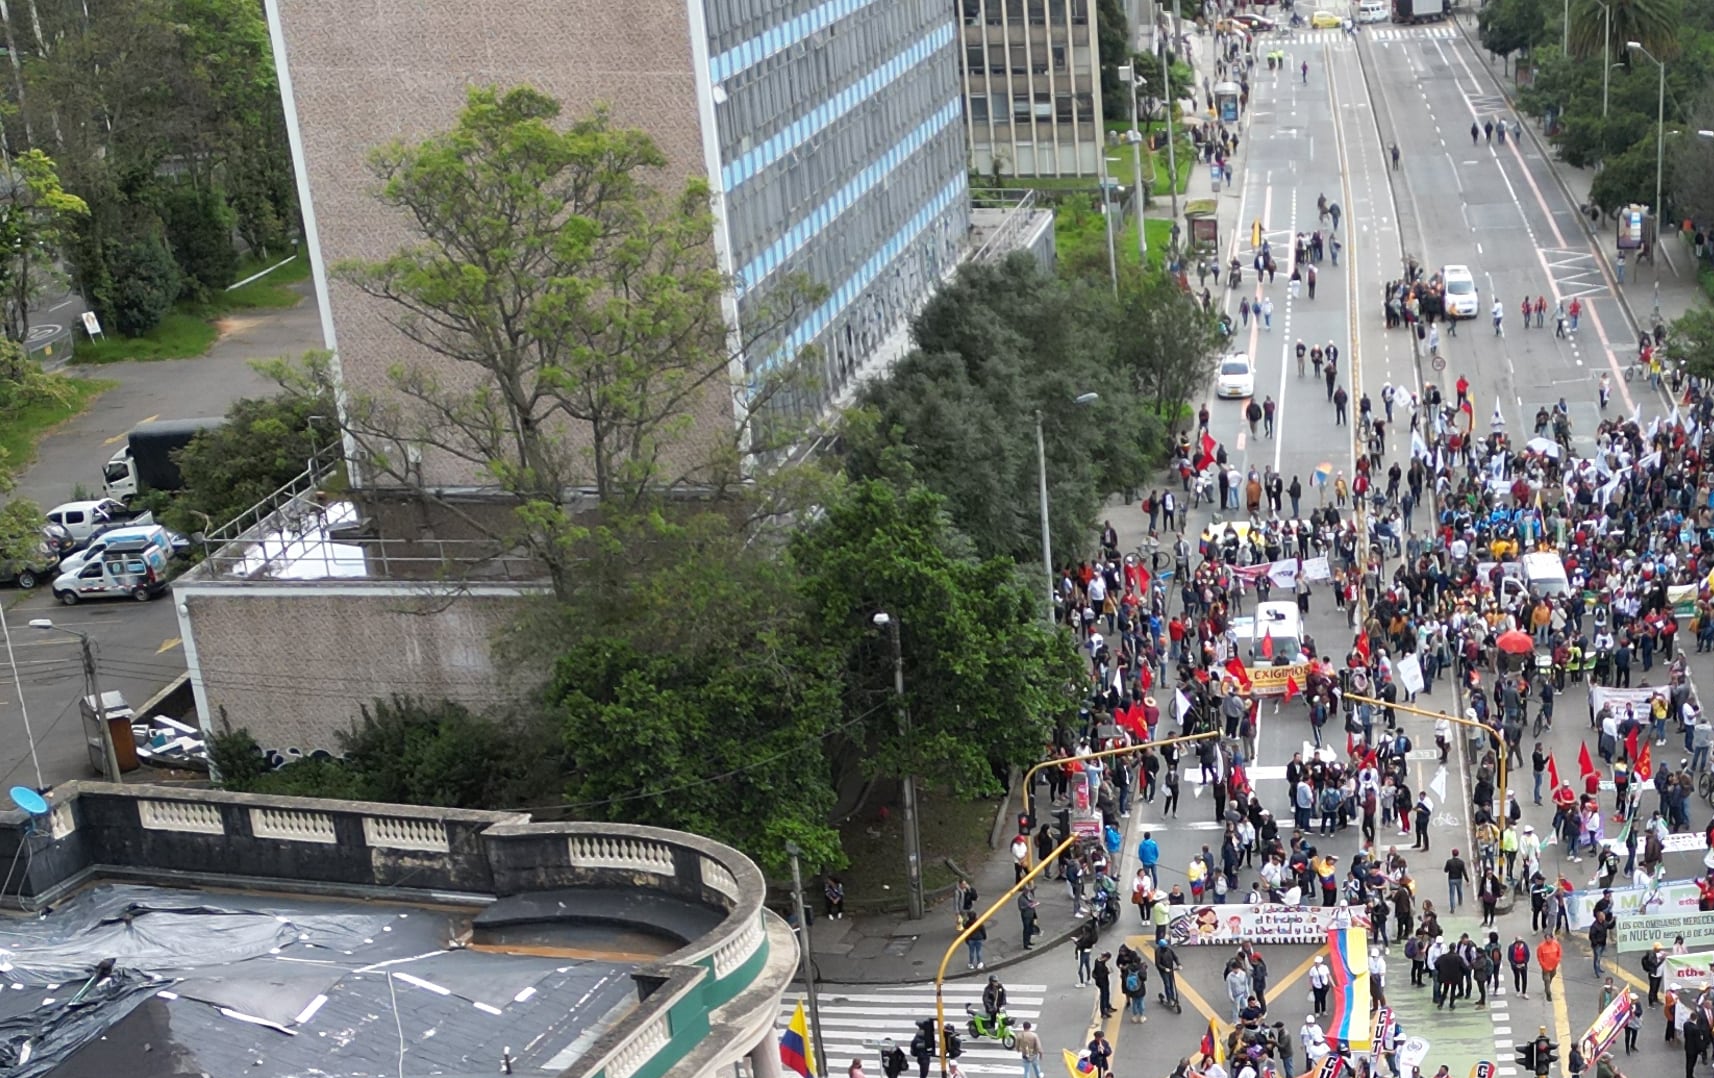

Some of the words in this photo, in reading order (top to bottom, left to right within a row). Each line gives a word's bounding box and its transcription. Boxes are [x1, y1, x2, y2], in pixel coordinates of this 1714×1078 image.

[1254, 664, 1311, 679] EXIGIMOS
[1618, 921, 1631, 930] LOS
[1630, 929, 1661, 941] NUEVO
